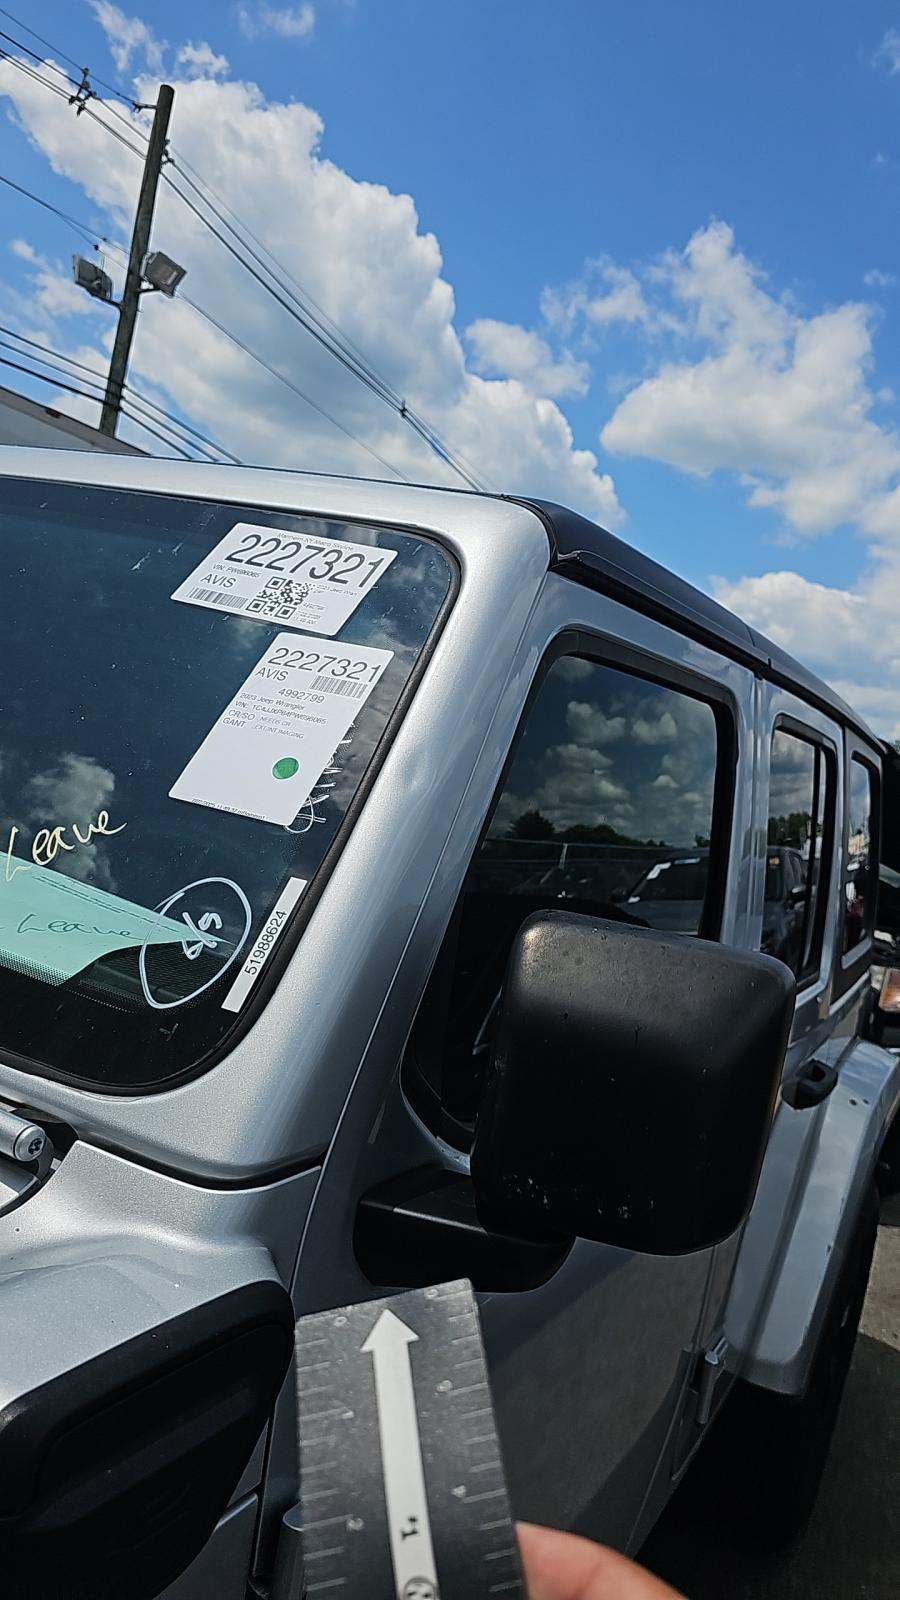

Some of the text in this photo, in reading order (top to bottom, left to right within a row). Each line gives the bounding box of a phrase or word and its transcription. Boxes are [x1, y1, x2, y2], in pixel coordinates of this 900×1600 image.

[224, 534, 385, 588] 2227321
[200, 573, 237, 588] AVIS
[267, 647, 382, 683] 2227321
[255, 667, 289, 682] AVIS
[257, 696, 274, 705] Jeep
[275, 699, 305, 711] Wrangler
[278, 688, 325, 704] 4992799
[222, 717, 246, 728] GANT
[5, 810, 128, 882] Leave
[244, 910, 288, 976] 51988624
